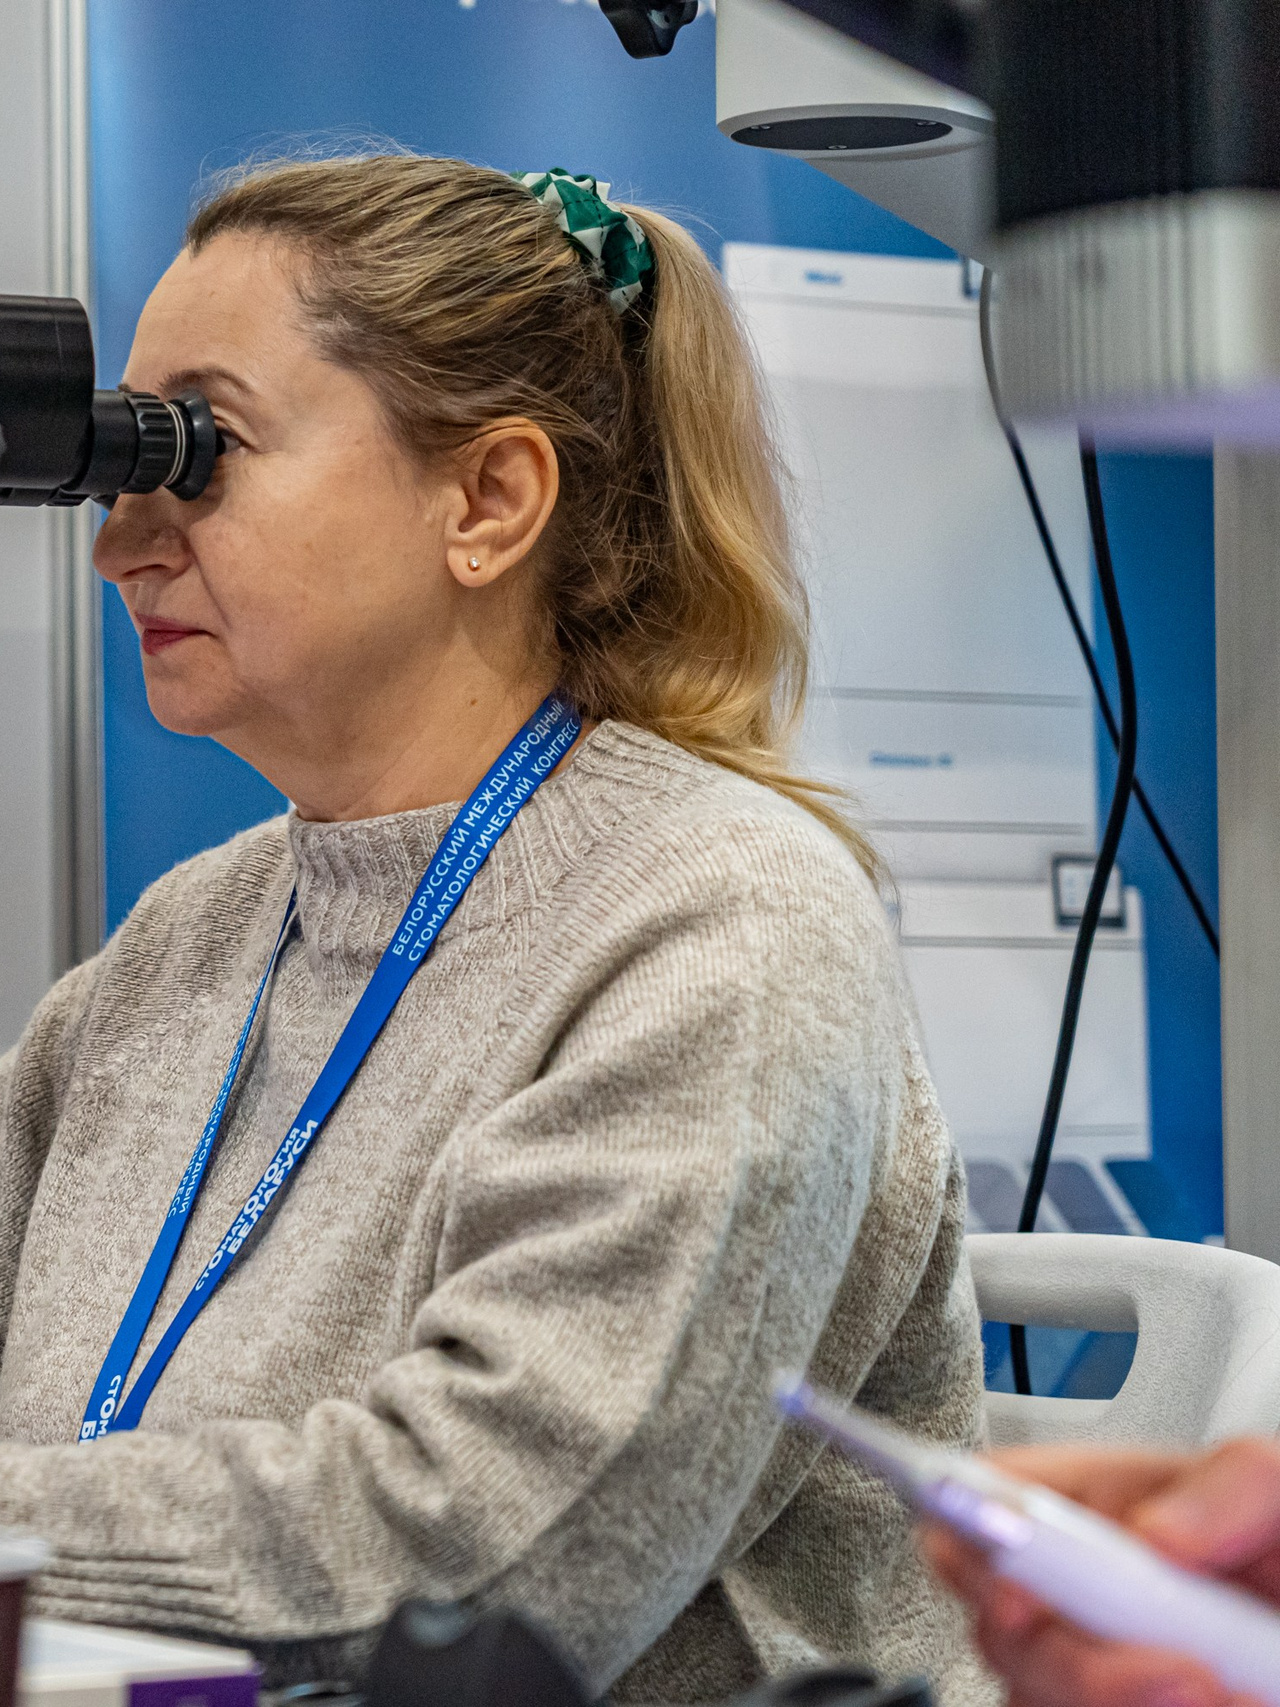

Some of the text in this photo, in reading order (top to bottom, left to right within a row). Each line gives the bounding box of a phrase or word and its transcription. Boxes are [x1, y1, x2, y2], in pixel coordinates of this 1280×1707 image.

[392, 699, 565, 956] БЕЛОРУССКИЙ МЕЖДУНАРОДНЫЙ
[408, 717, 580, 962] СТОМАТОЛОГИЧЕСКИЙ КОНГРЕСС
[195, 1127, 300, 1292] СТОМАТОЛОГИЯ
[226, 1119, 320, 1255] БЕЛАРУСИ
